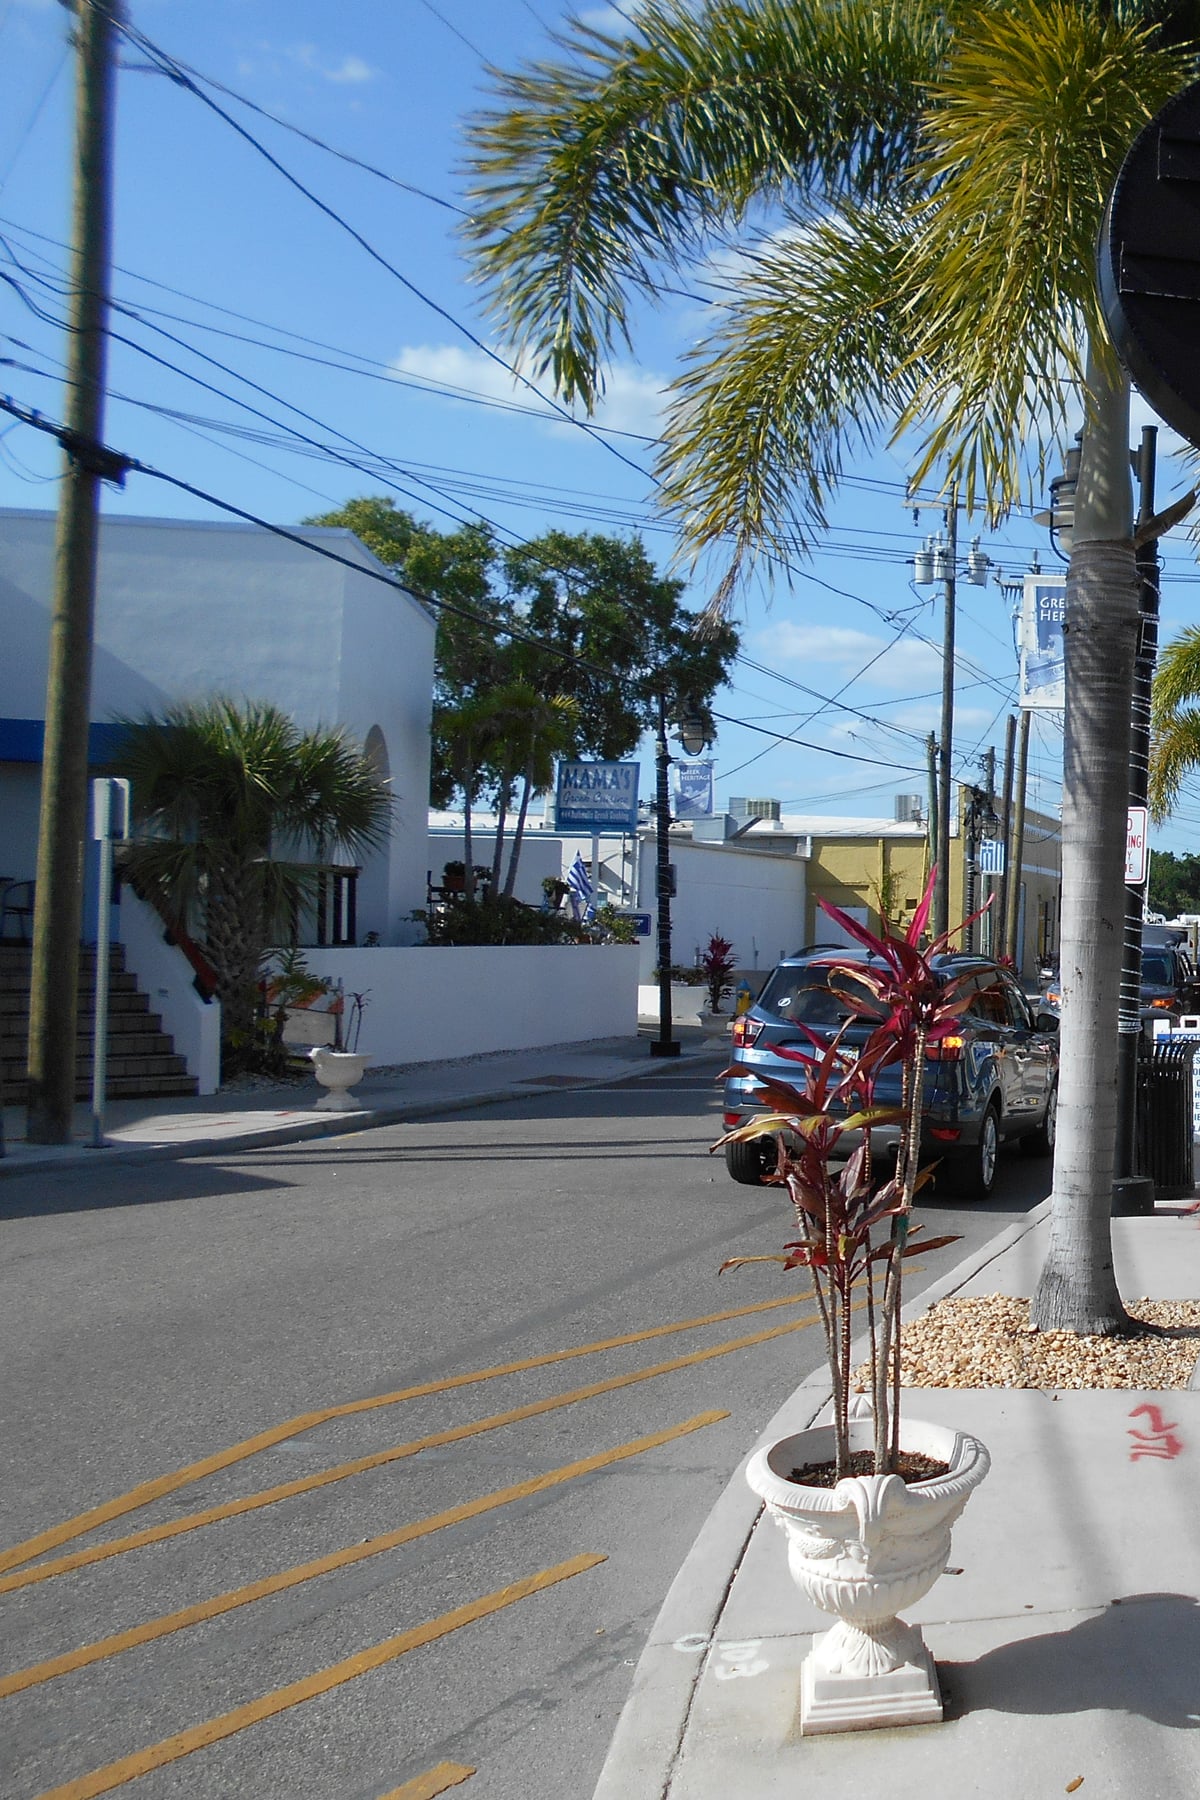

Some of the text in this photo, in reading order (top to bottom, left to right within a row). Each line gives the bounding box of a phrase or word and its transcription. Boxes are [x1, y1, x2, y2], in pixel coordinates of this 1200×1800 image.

[1040, 597, 1065, 608] GRE
[563, 768, 631, 790] MAMA'S
[1127, 835, 1142, 849] ING
